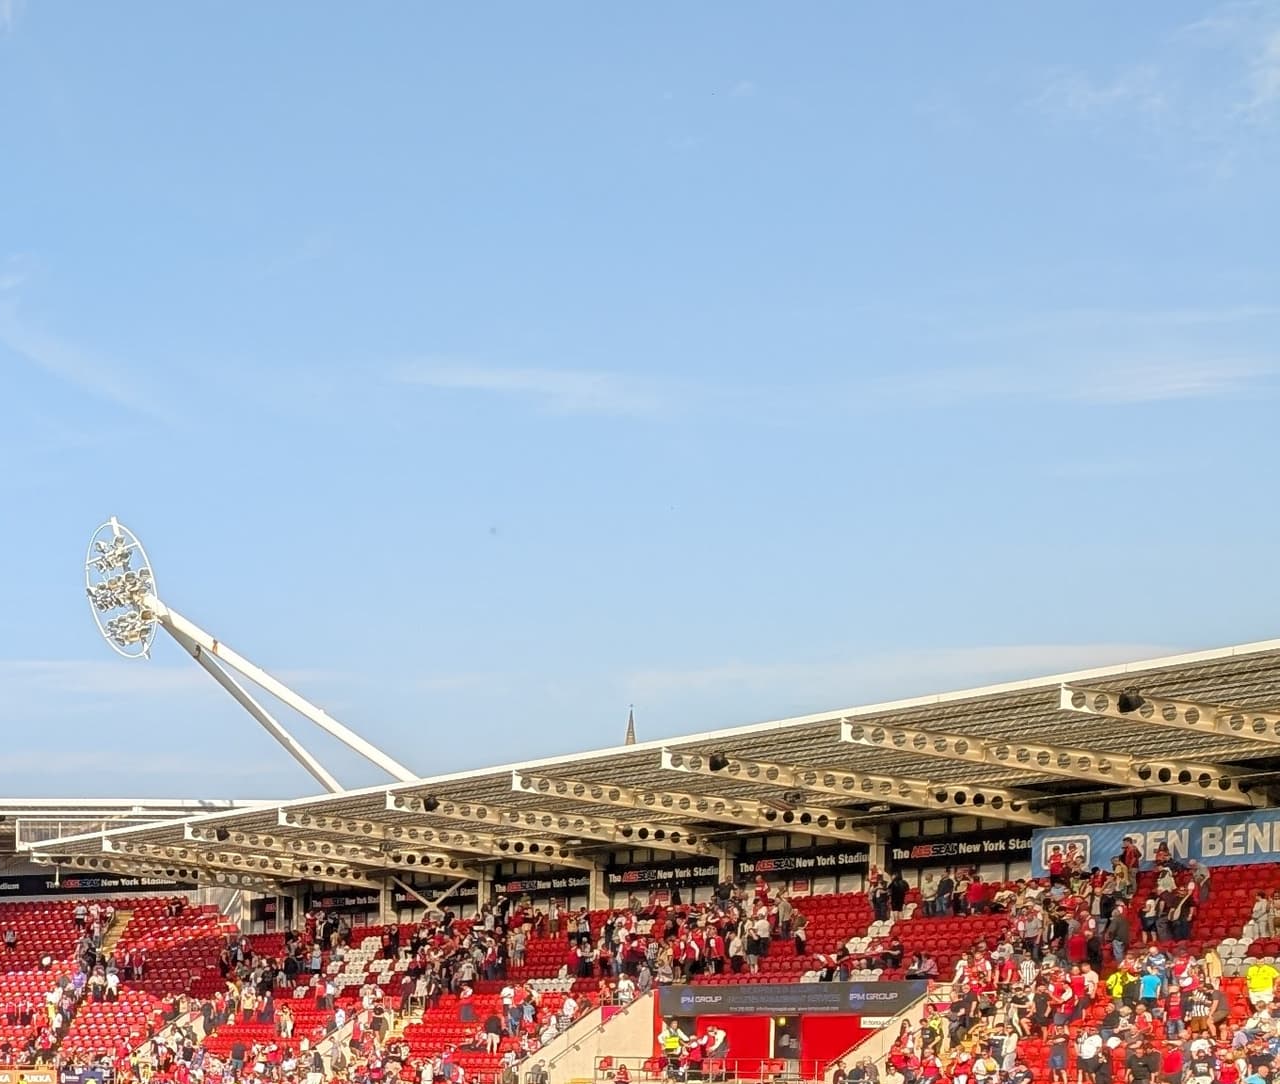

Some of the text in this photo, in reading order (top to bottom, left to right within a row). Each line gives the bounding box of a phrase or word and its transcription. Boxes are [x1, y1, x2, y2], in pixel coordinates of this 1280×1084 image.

[1201, 822, 1280, 857] BEN
[893, 848, 909, 859] The
[959, 842, 980, 854] New
[982, 839, 1006, 852] York
[1008, 838, 1032, 849] Stad
[740, 863, 754, 873] The
[795, 858, 814, 868] New
[816, 855, 836, 866] York
[838, 853, 868, 864] Stadiu
[609, 873, 621, 883] The
[657, 869, 673, 879] New
[675, 867, 691, 877] York
[101, 878, 138, 887] New York
[552, 878, 567, 888] York
[695, 996, 722, 1004] GROUP
[866, 992, 898, 1001] GROUP
